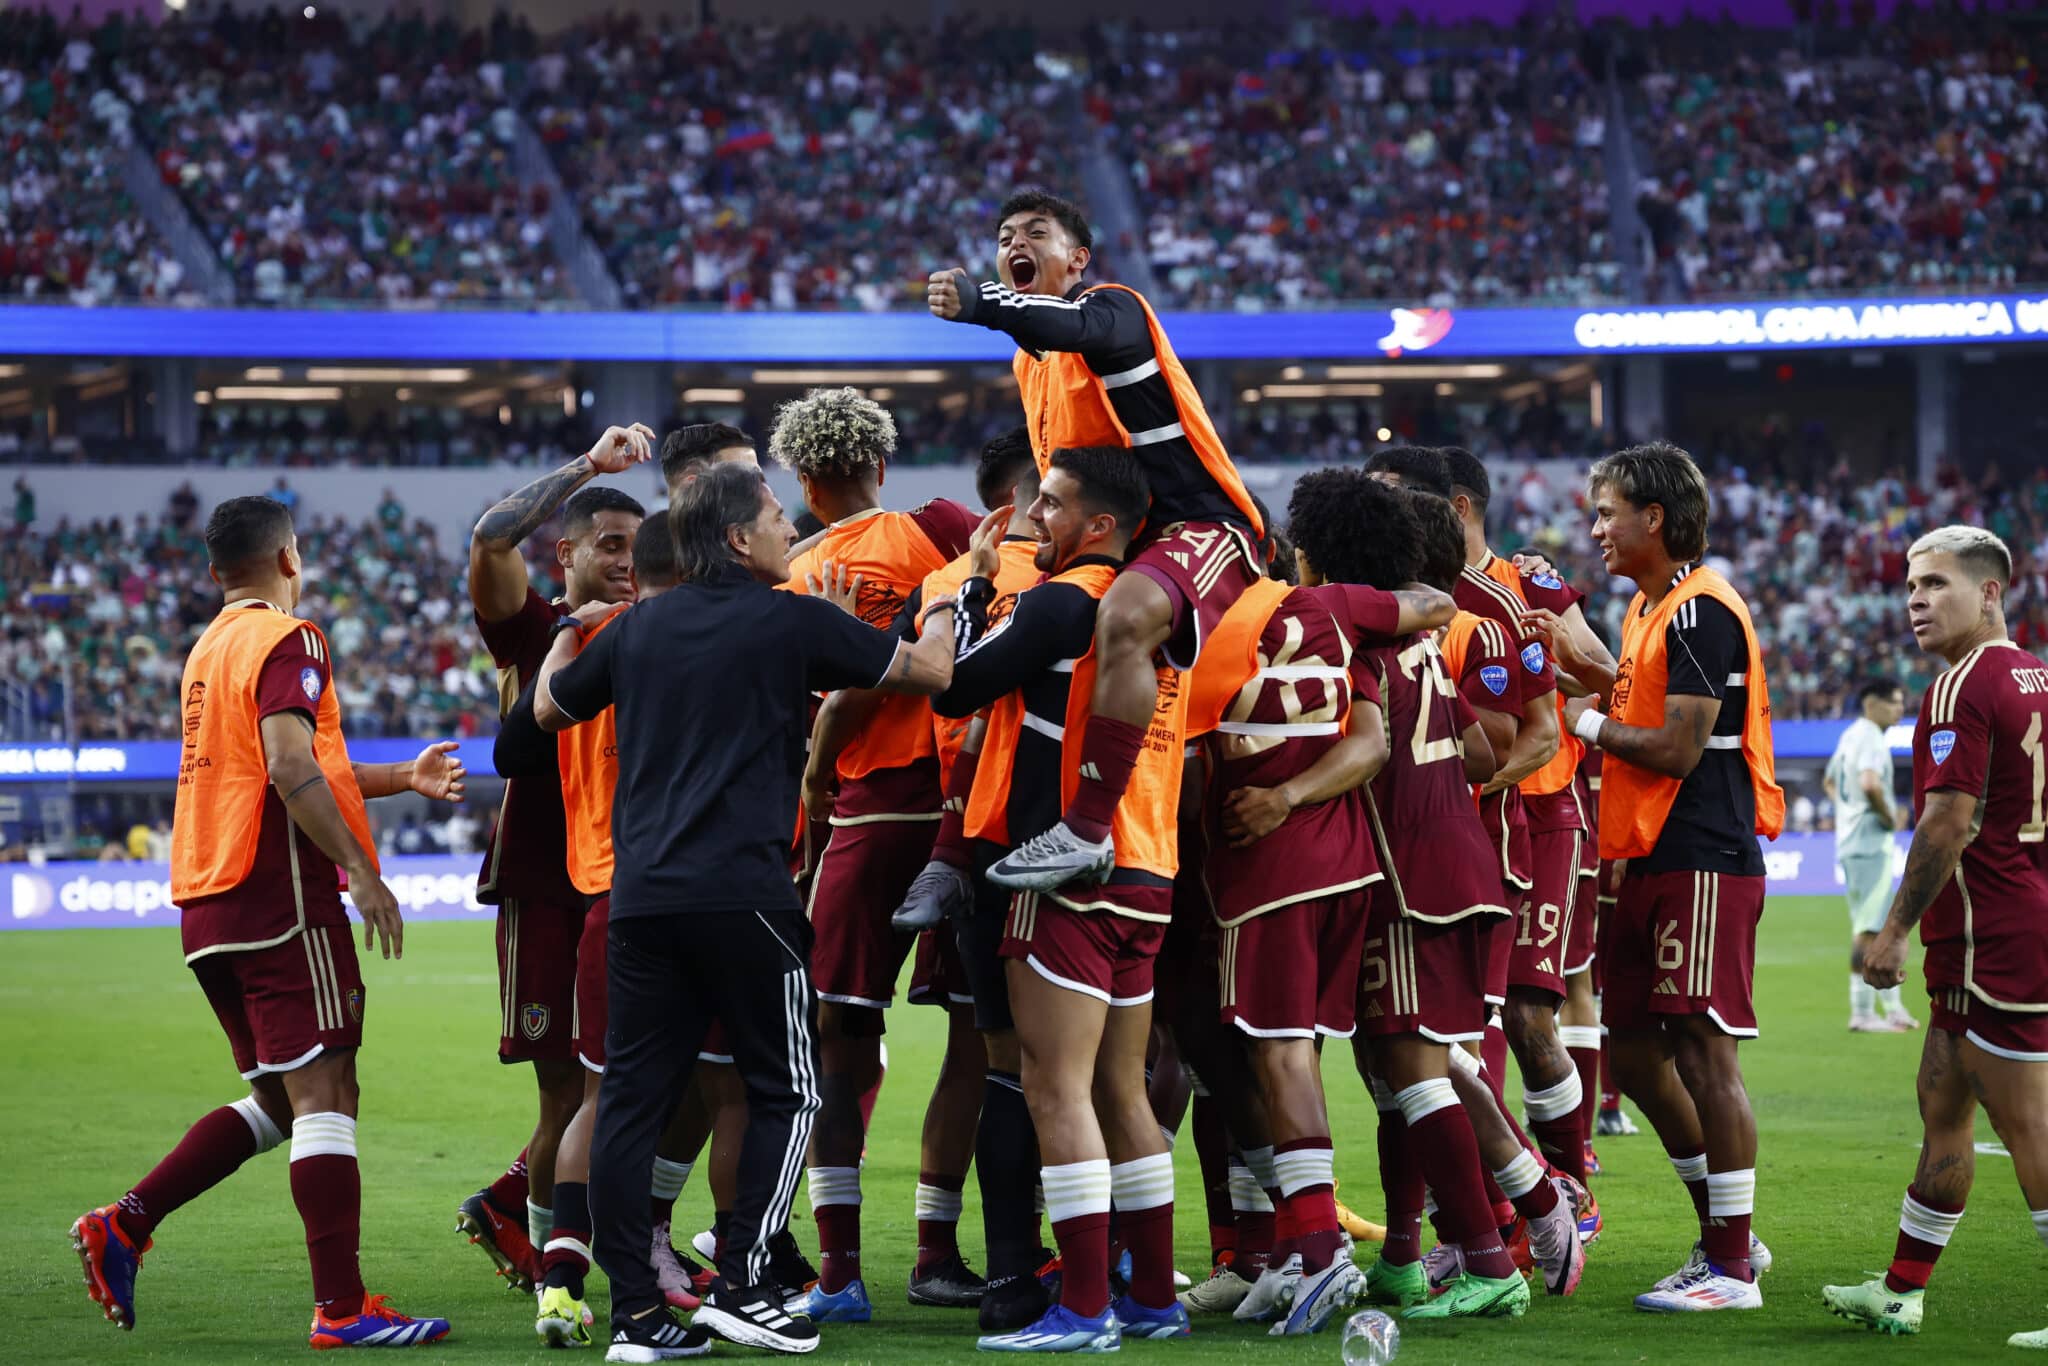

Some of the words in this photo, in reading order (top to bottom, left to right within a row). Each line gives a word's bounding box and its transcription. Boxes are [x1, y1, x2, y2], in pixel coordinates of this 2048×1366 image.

[1574, 311, 1764, 348] CONMEBOL
[1764, 307, 1858, 343] COPA
[1859, 302, 2013, 340] AMERICA
[2011, 668, 2048, 693] SOTE
[1516, 901, 1560, 947] 19
